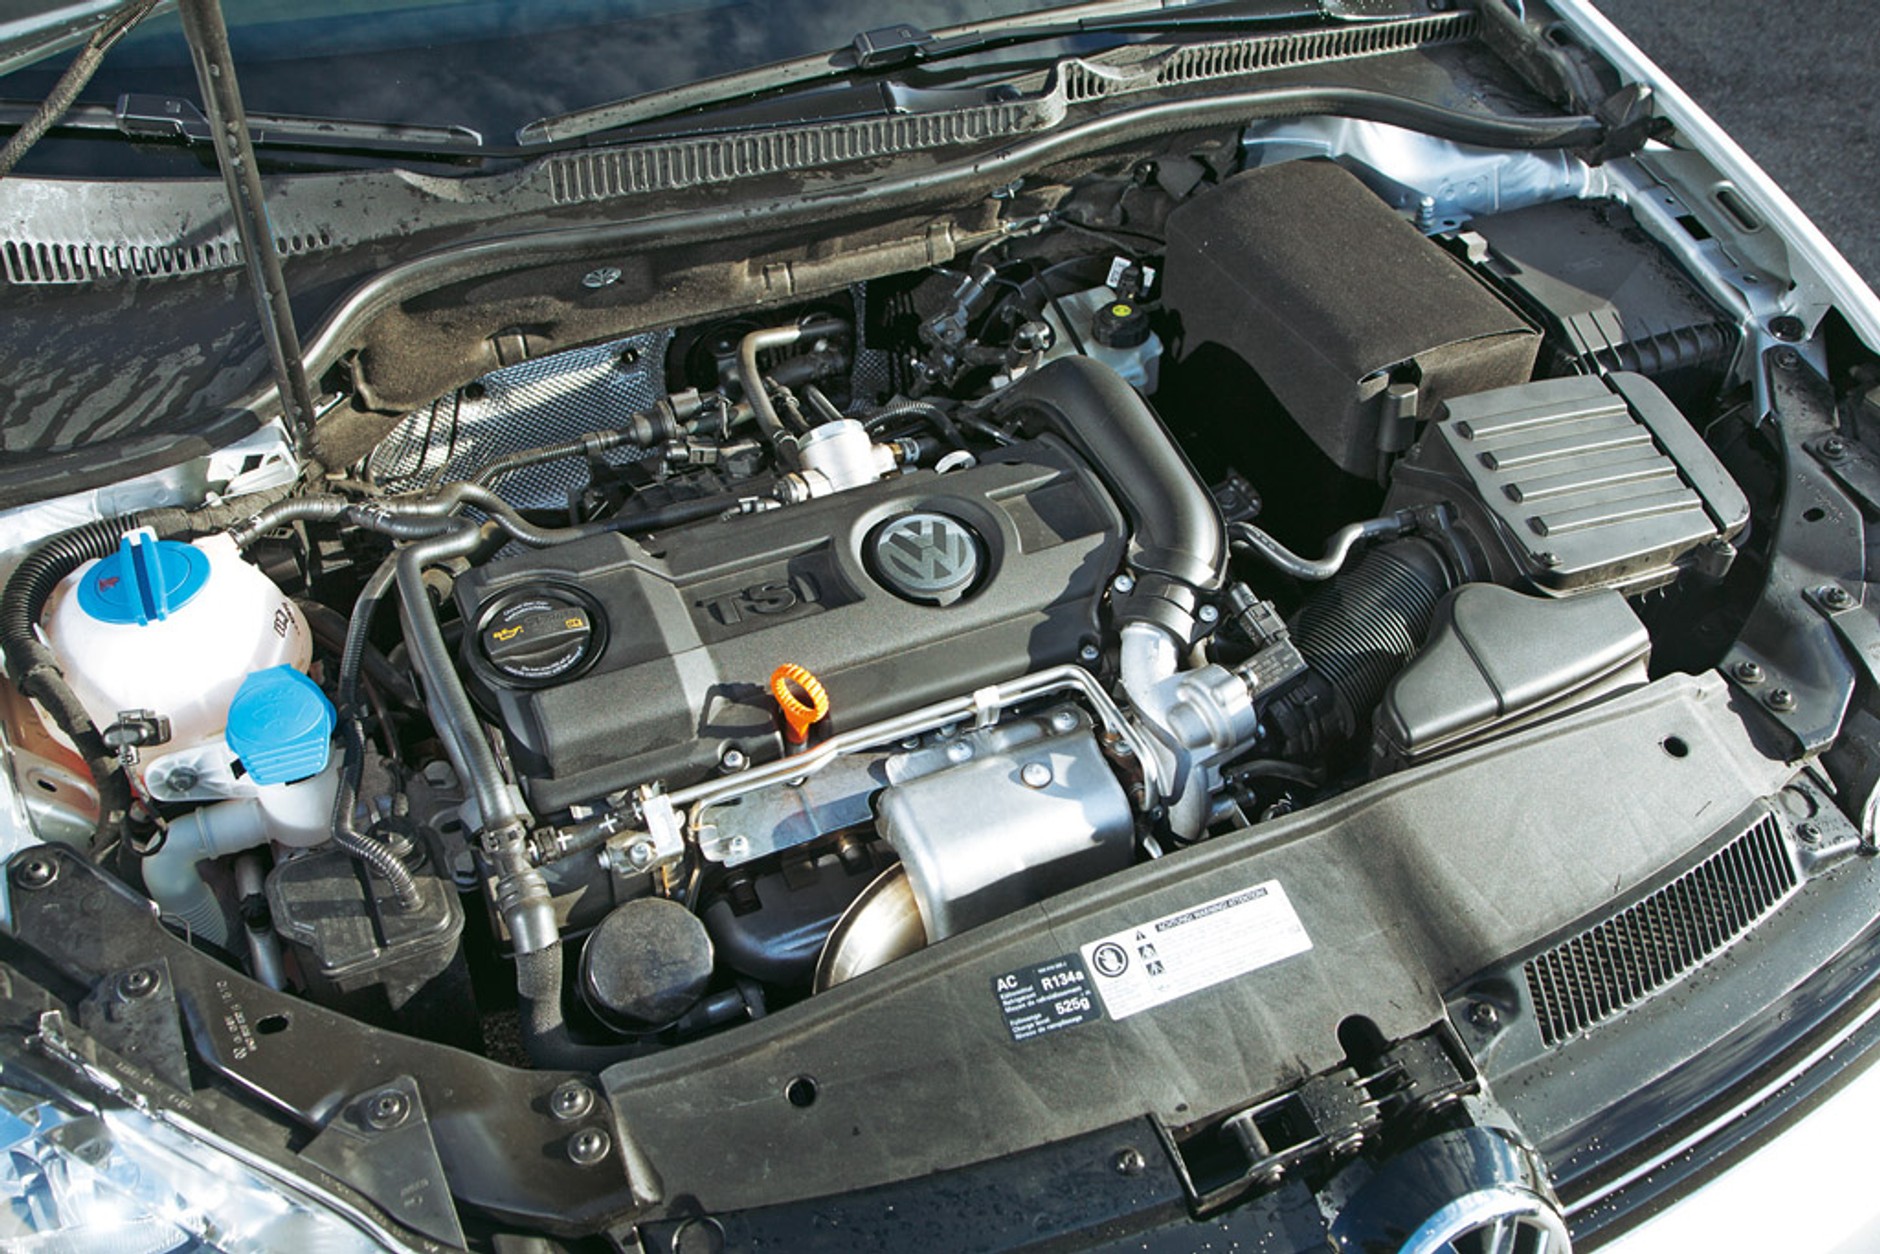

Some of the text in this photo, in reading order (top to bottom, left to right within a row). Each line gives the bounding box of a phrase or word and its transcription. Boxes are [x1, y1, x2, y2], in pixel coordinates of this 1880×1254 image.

[695, 574, 817, 625] TSI
[996, 974, 1018, 992] AC
[1040, 970, 1085, 991] R134a
